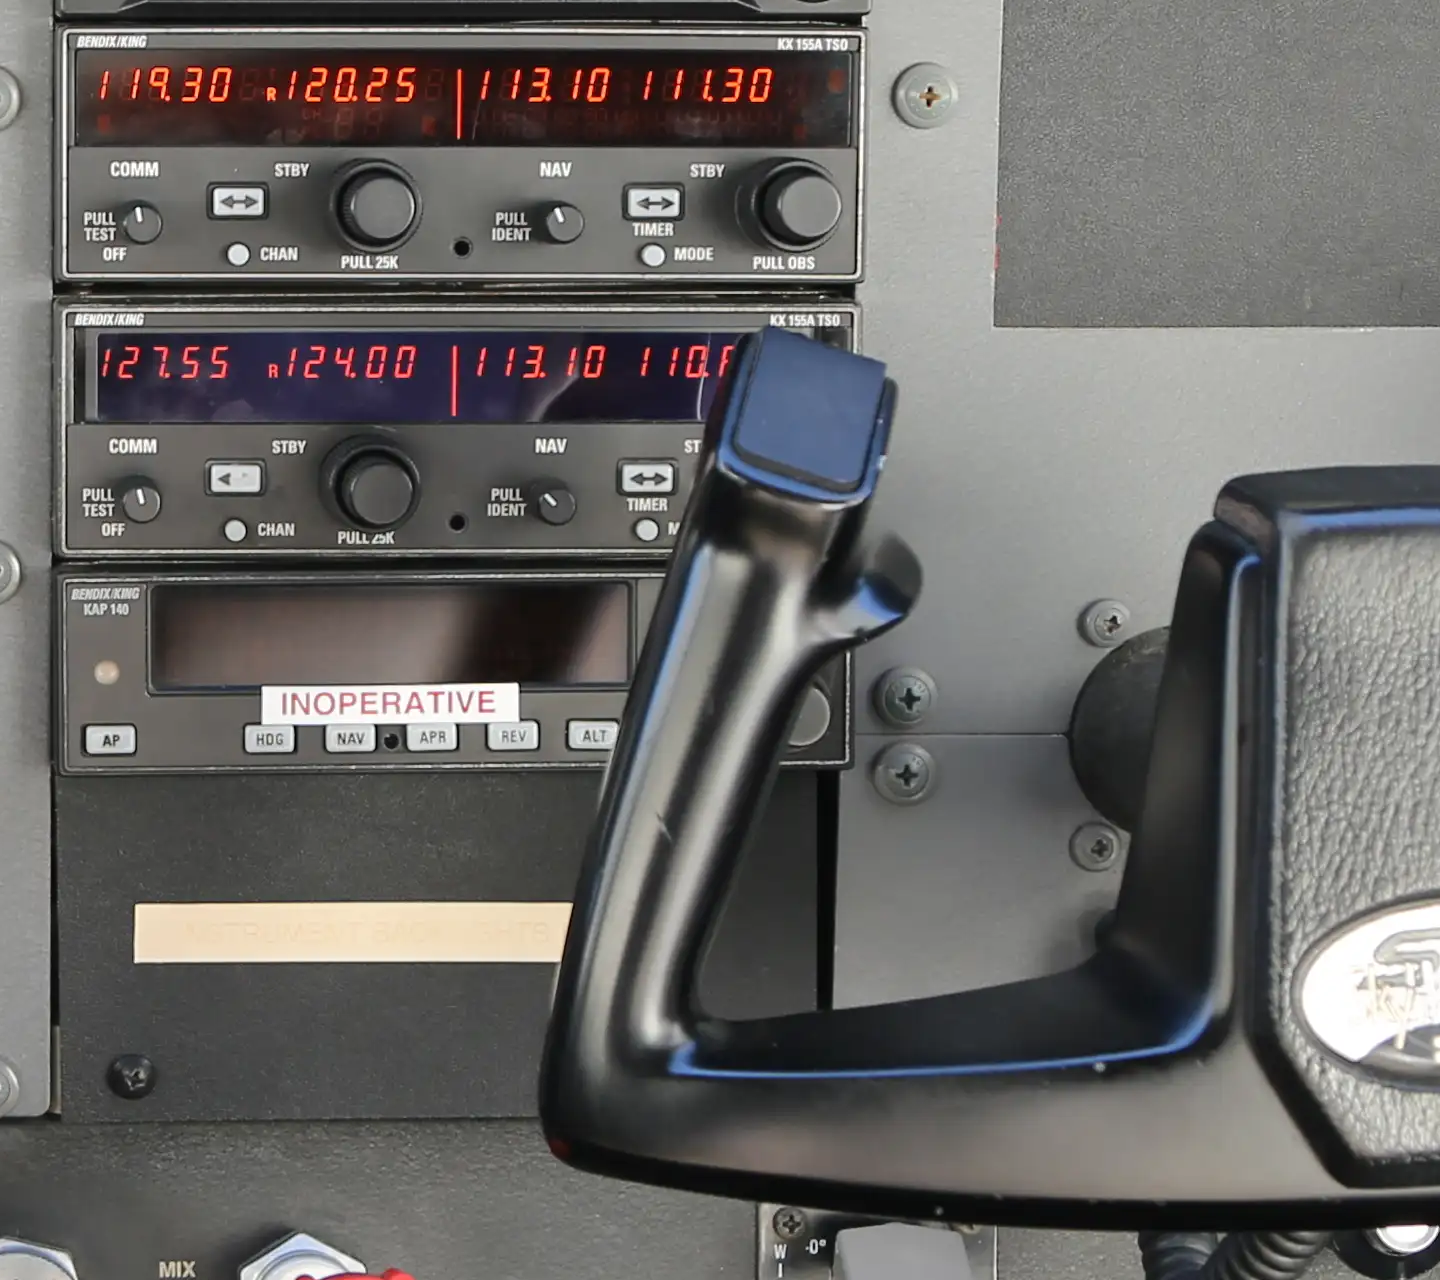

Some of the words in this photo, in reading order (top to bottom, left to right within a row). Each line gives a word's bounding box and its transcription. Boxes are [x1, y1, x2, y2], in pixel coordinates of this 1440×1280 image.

[98, 66, 234, 103] 119.30
[479, 66, 613, 103] 113.10
[110, 161, 159, 177] COMM
[274, 162, 310, 178] STBY
[540, 161, 572, 177] NAV
[631, 222, 674, 237] TIMER
[260, 246, 298, 261] CHAN
[674, 246, 714, 261] MODE
[340, 255, 374, 270] PULL
[374, 255, 399, 270] 25K
[281, 690, 496, 716] INOPERATIVE
[102, 734, 121, 747] AP
[256, 732, 284, 747] HDG
[337, 732, 365, 746] NAV
[419, 730, 447, 744] APR
[501, 729, 527, 744] REV
[582, 729, 607, 743] ALT
[159, 1260, 196, 1279] MIX
